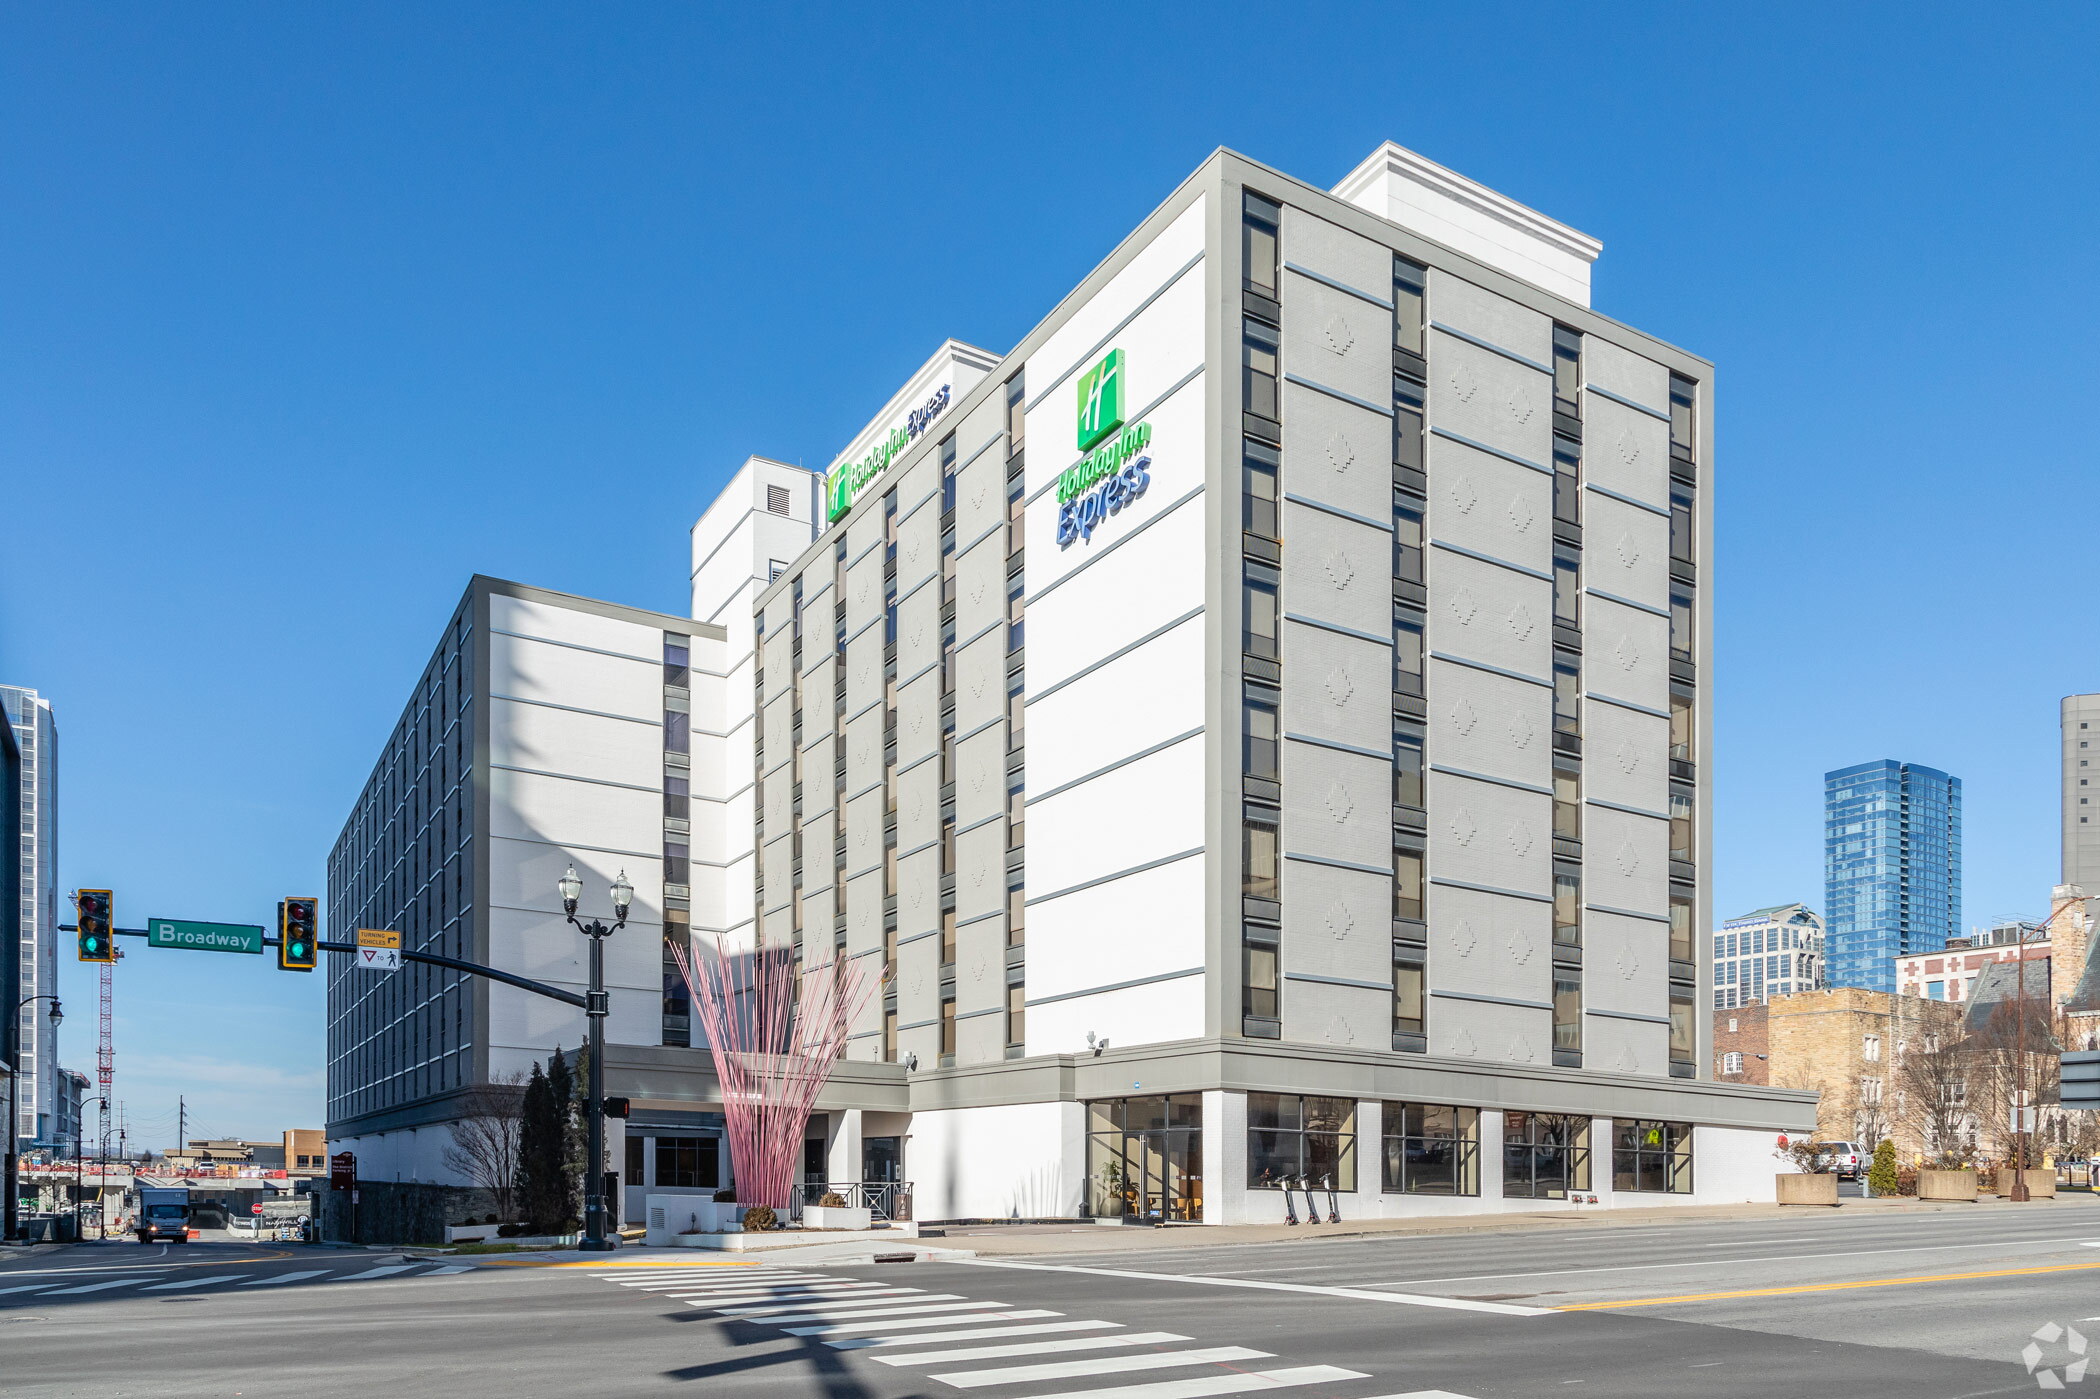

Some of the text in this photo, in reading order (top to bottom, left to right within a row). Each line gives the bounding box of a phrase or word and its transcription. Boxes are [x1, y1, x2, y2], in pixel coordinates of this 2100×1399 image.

[851, 384, 951, 493] Holiday Inn Express
[1056, 420, 1153, 504] Holiday Inn
[1056, 456, 1152, 546] Express
[159, 923, 251, 950] Broadway
